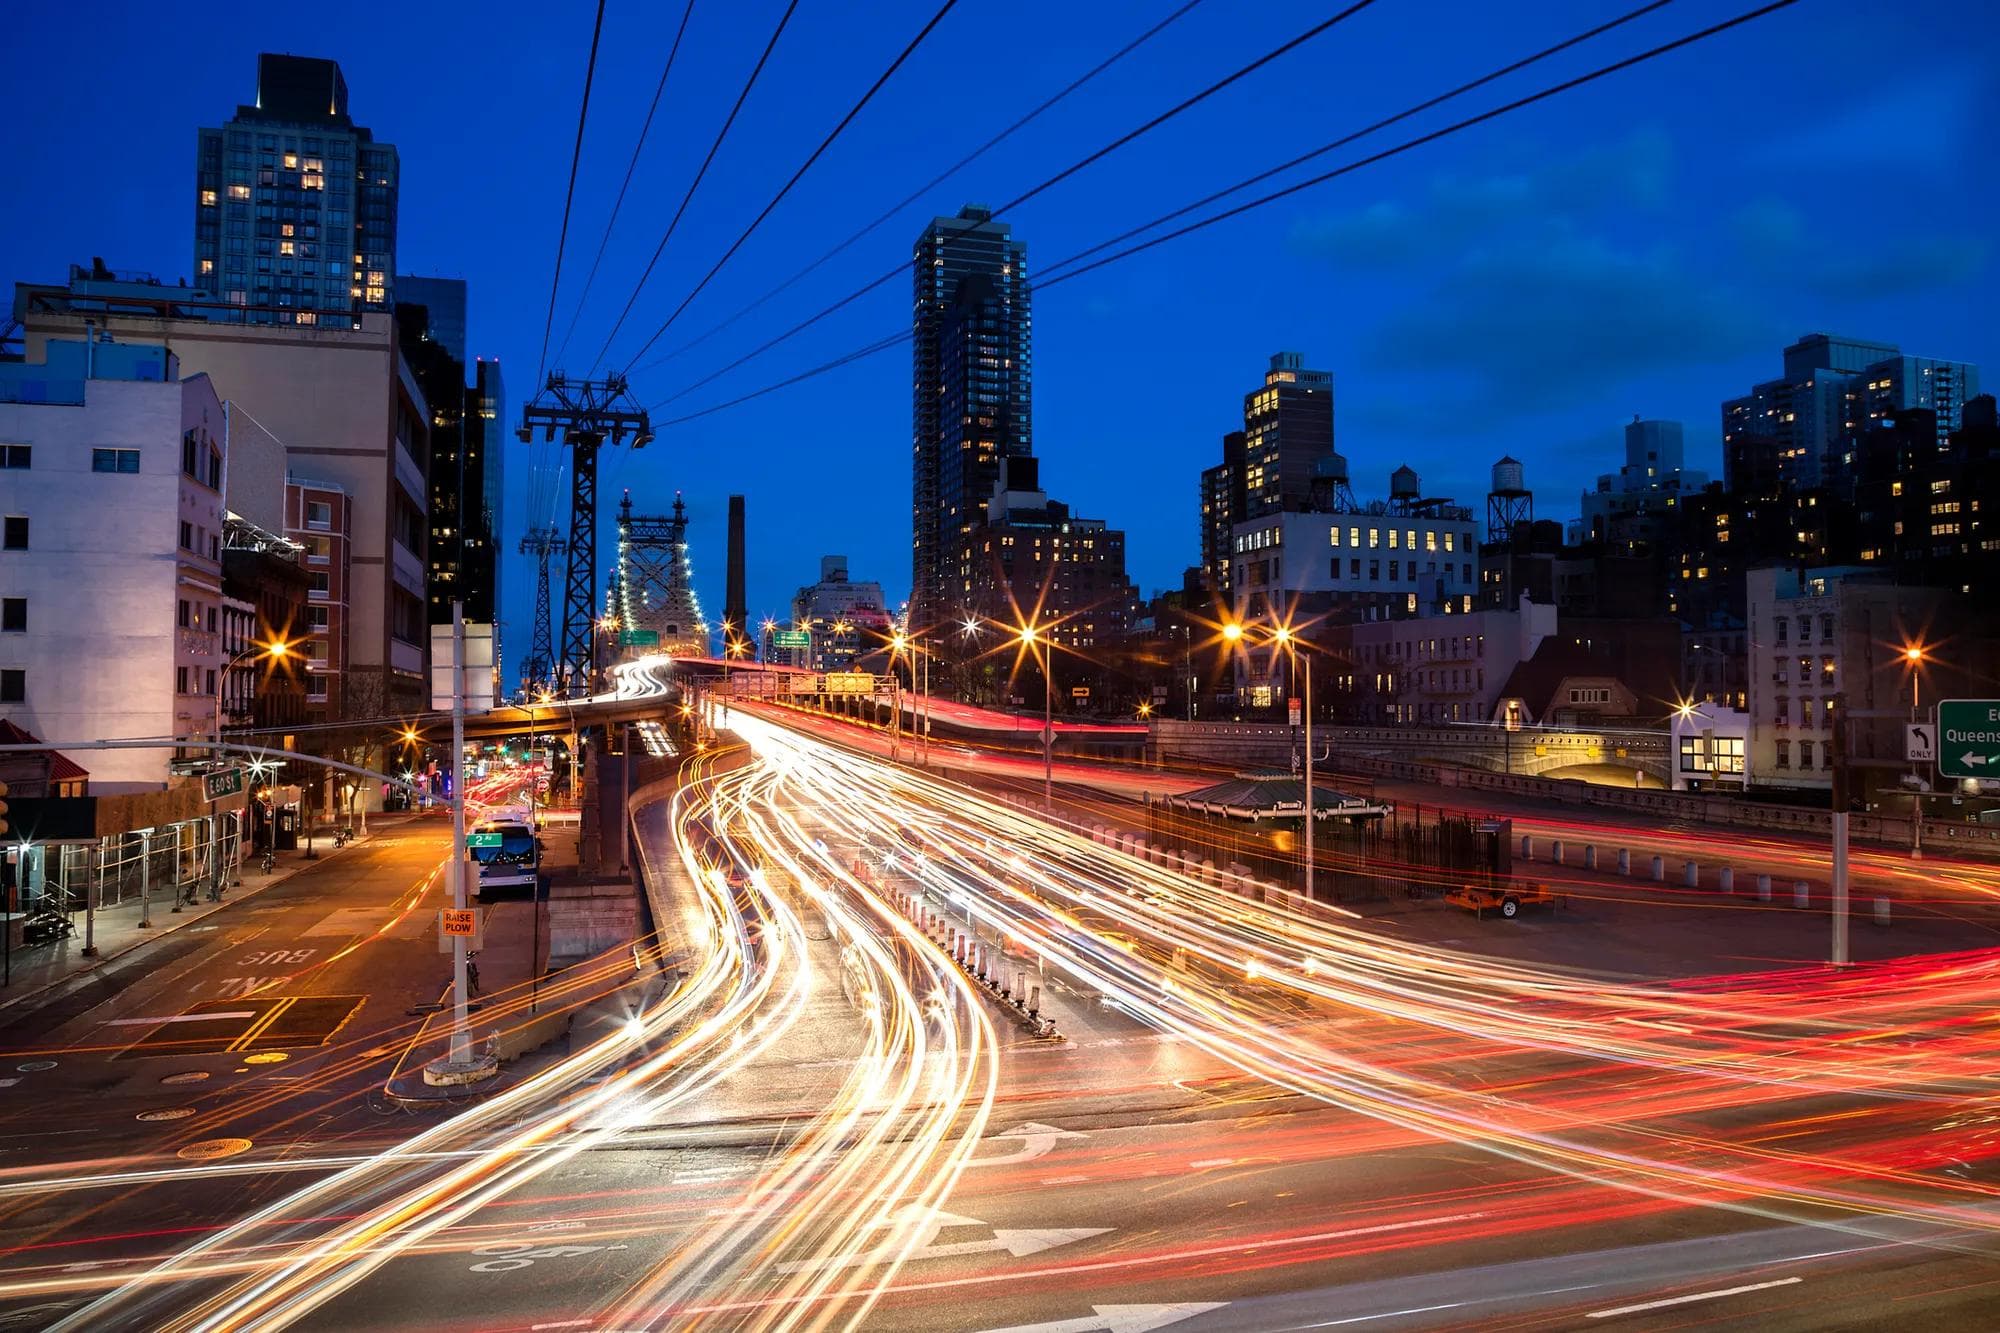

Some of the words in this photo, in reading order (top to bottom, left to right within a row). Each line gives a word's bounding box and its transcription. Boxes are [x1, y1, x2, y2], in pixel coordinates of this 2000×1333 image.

[1989, 709, 2000, 721] E
[1910, 750, 1932, 758] ONLY
[215, 777, 225, 793] 60
[475, 835, 483, 846] 2
[446, 912, 471, 922] RAISE
[446, 923, 471, 932] PLOW
[237, 949, 317, 966] BUS
